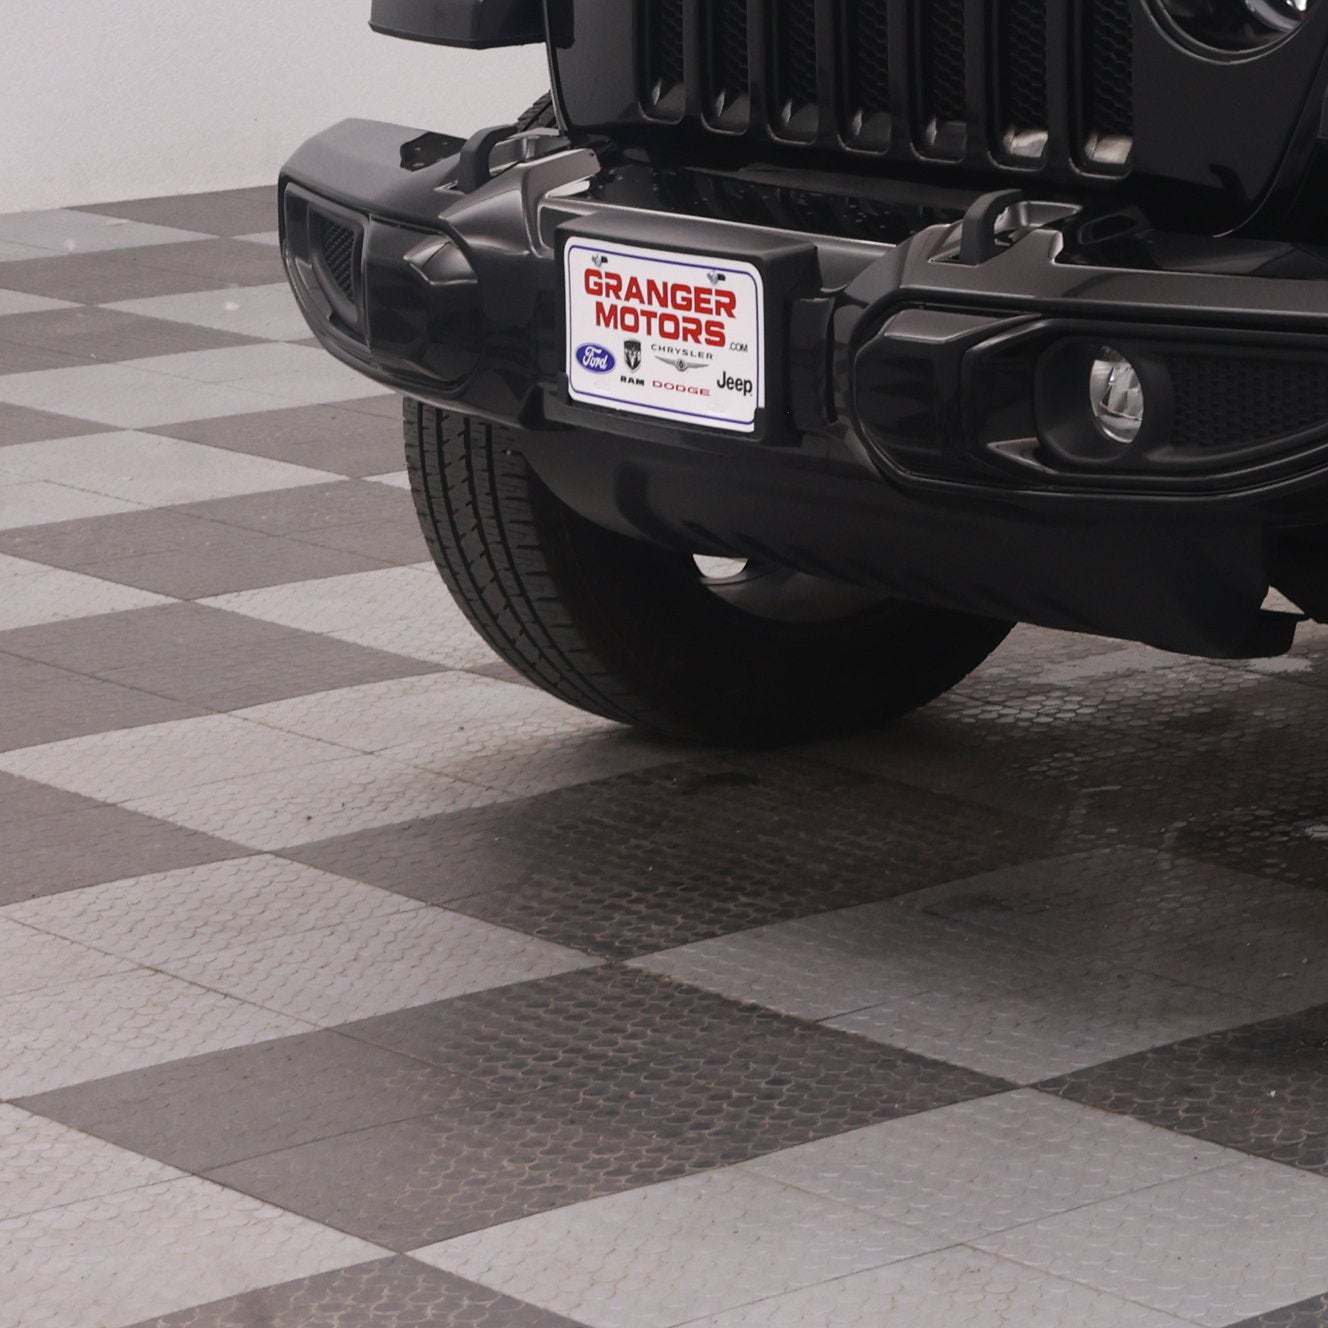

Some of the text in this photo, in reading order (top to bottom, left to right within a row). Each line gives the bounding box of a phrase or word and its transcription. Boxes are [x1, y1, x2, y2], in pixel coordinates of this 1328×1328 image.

[584, 268, 737, 319] GRANGER
[595, 301, 726, 348] MOTORS
[582, 346, 608, 369] Ford
[651, 343, 714, 360] CHRYSLER
[729, 342, 748, 353] .COM
[620, 375, 645, 387] RAM
[652, 380, 710, 397] DODGE
[716, 371, 753, 396] Jeep
